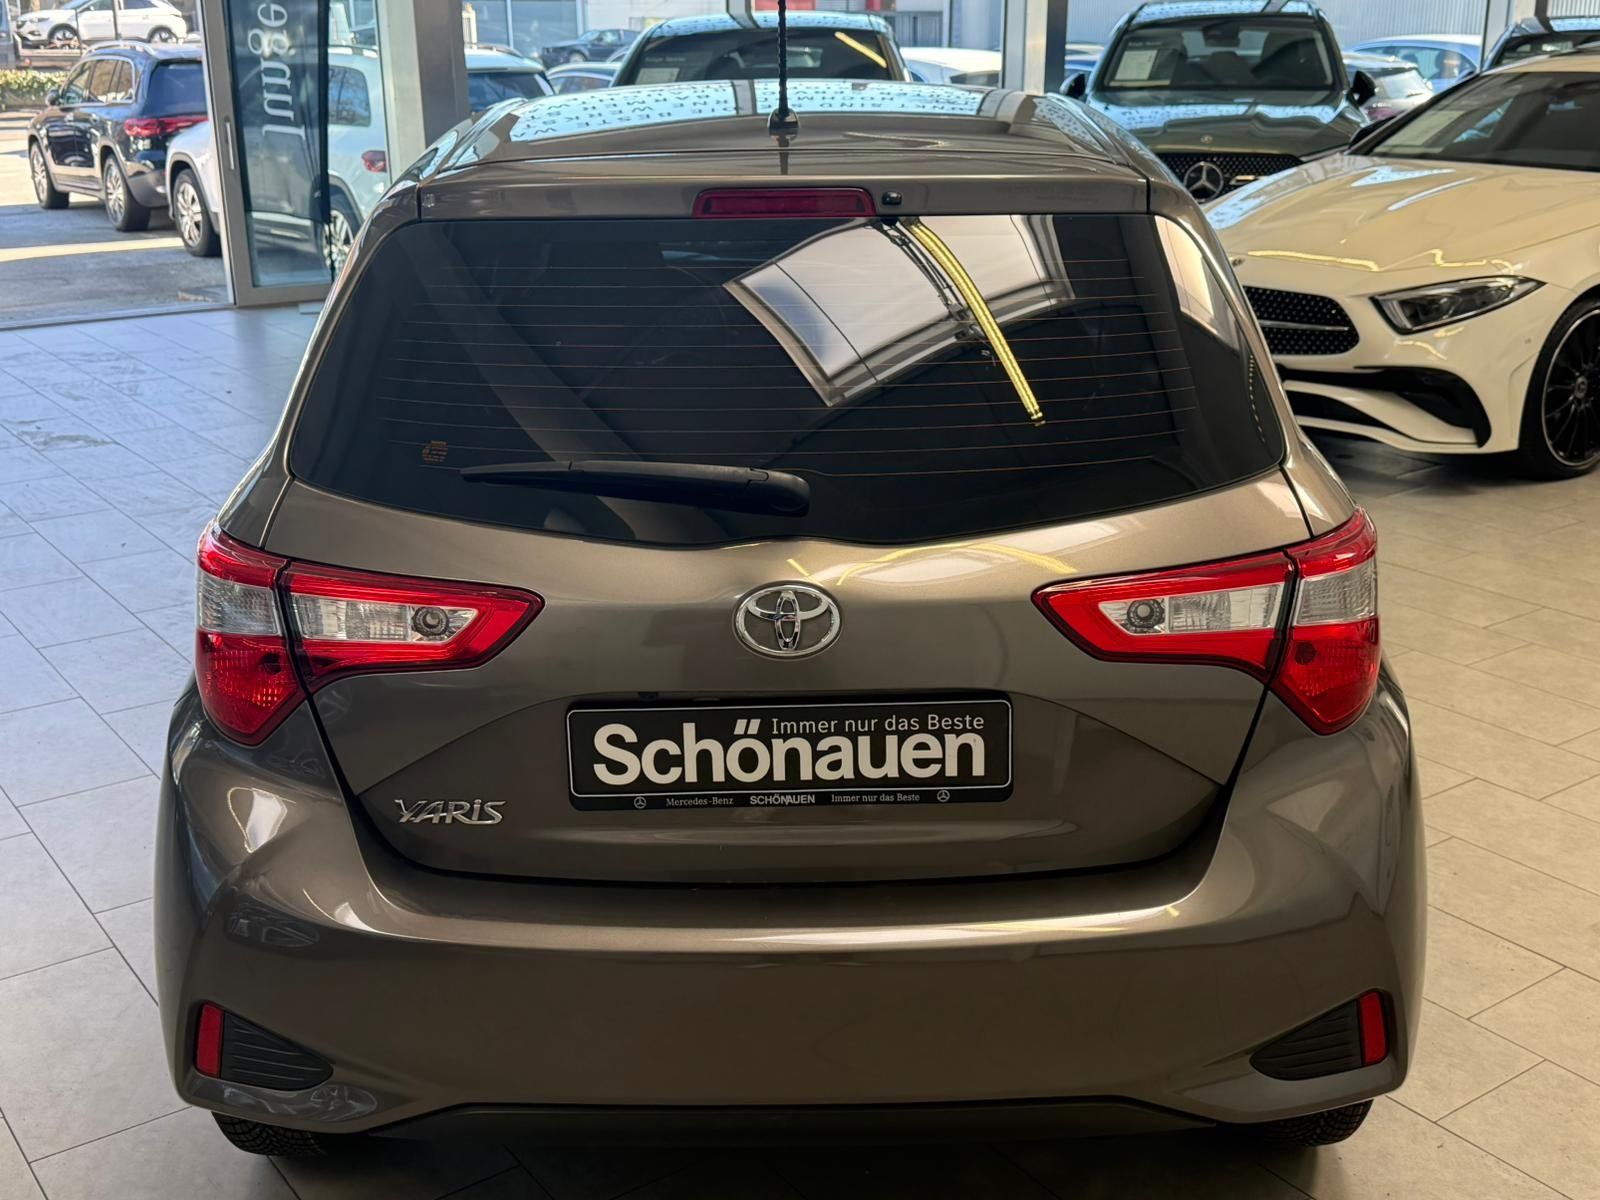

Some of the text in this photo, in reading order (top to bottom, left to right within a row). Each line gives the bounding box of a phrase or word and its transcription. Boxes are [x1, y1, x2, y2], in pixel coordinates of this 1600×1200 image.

[772, 714, 984, 734] Immer nur das Beste
[593, 719, 985, 785] Schönauen
[666, 793, 920, 807] Mercedes-Benz SCHÖNAUEN Immer nur das Beste
